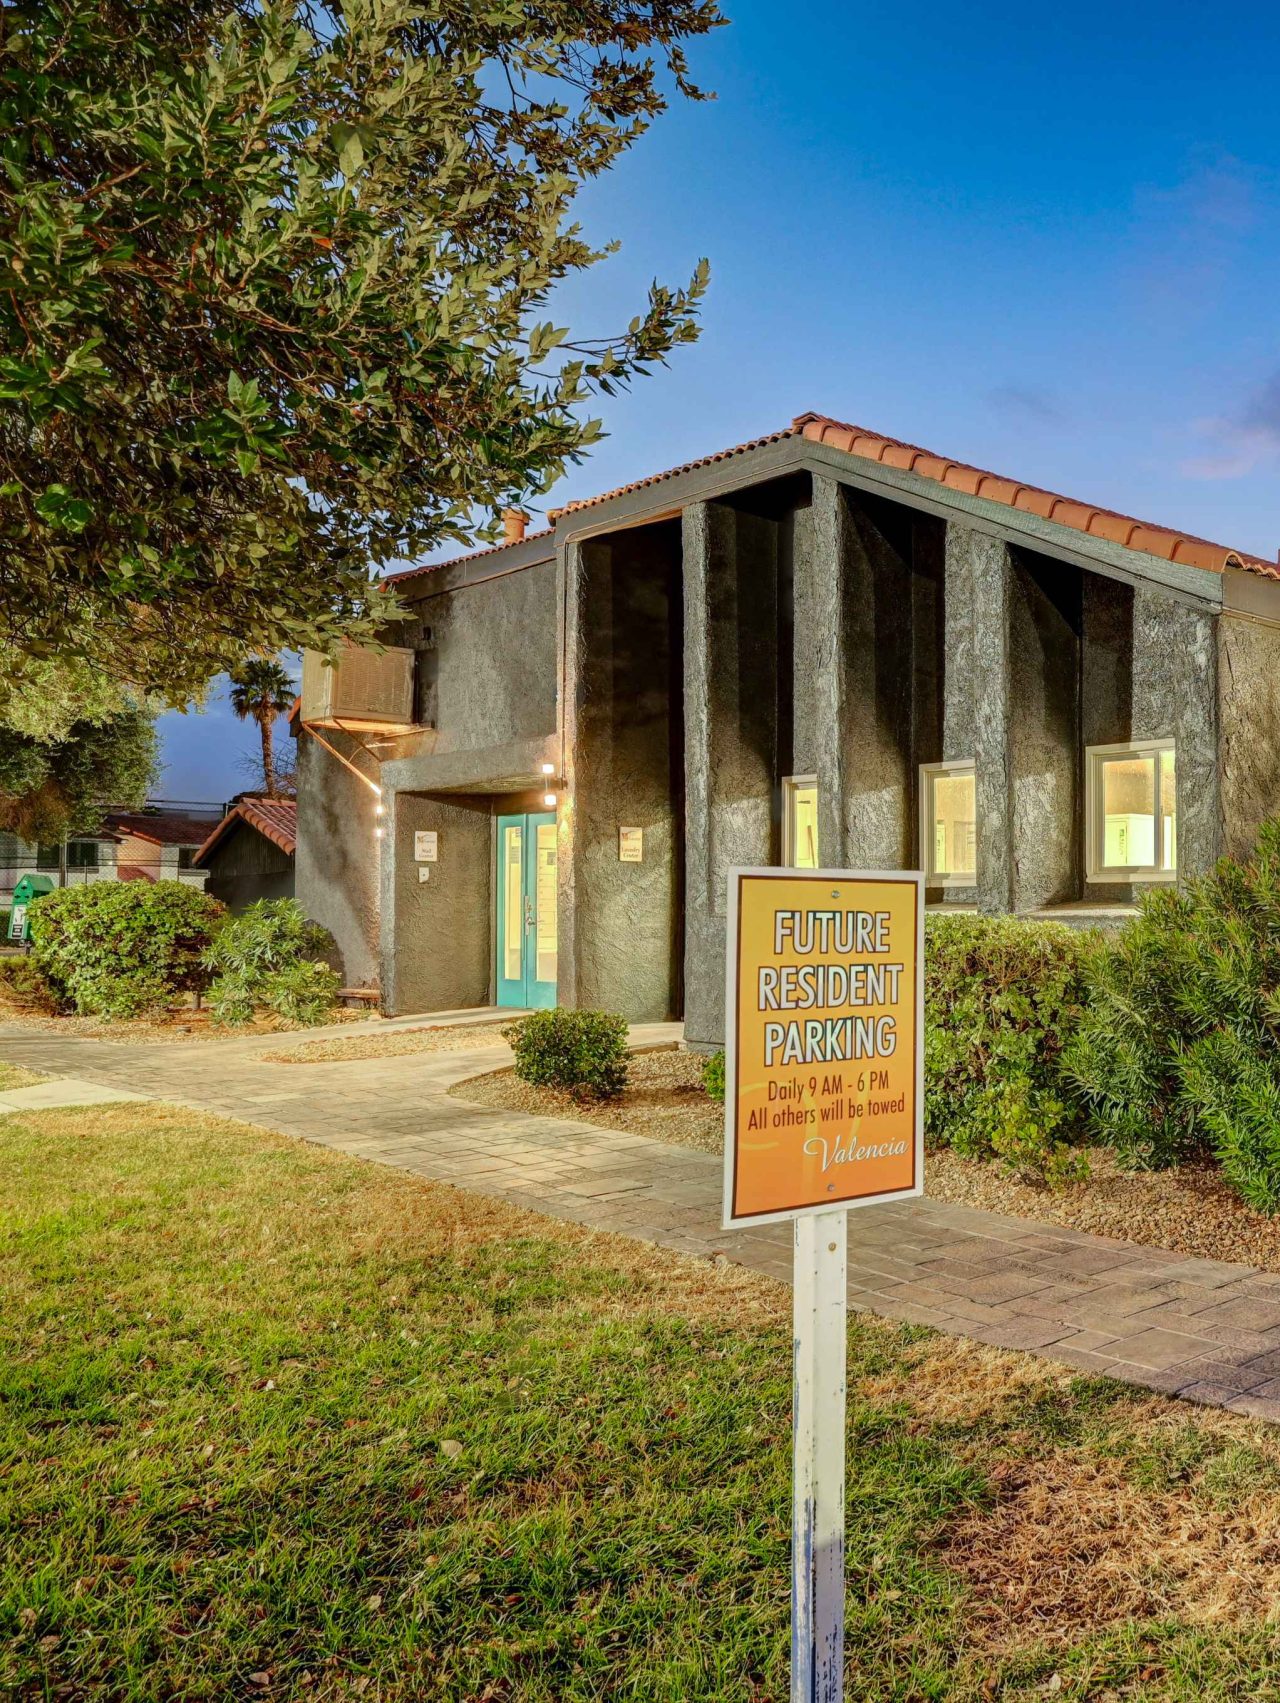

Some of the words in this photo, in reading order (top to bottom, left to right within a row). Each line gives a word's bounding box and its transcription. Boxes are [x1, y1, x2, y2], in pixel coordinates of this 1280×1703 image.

[774, 910, 890, 954] FUTURE
[758, 963, 904, 1011] RESIDENT
[764, 1015, 896, 1067] PARKING
[768, 1077, 804, 1103] Daily
[809, 1076, 817, 1096] 9
[822, 1074, 842, 1095] AM
[857, 1072, 865, 1092] 6
[869, 1070, 889, 1091] PM
[748, 1107, 767, 1130] All
[773, 1105, 815, 1128] others
[820, 1099, 843, 1122] will
[848, 1098, 863, 1118] be
[868, 1092, 905, 1116] towed
[803, 1135, 908, 1172] Valencia
